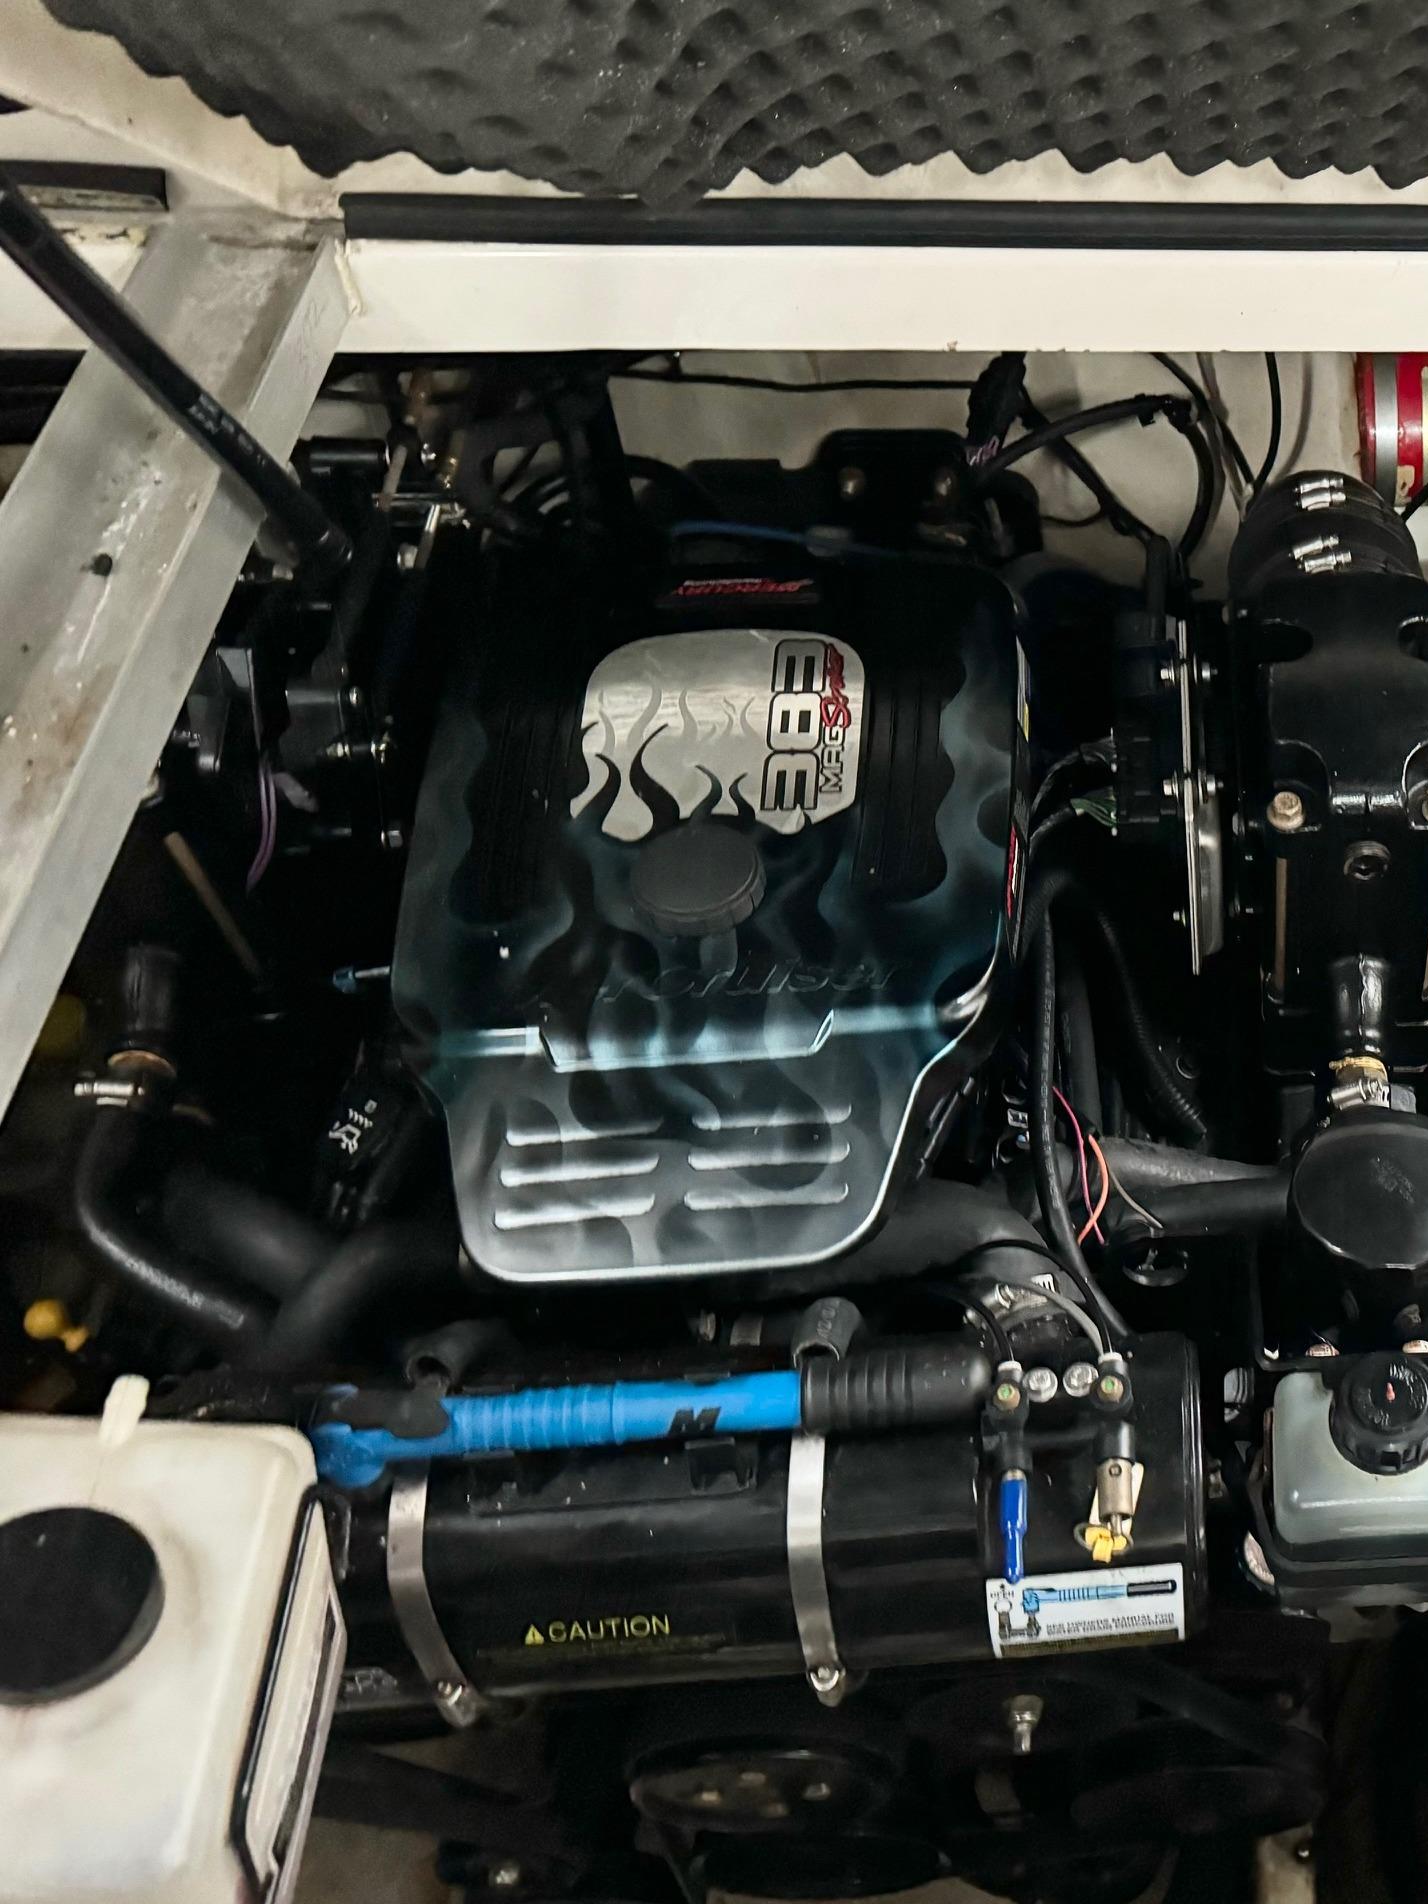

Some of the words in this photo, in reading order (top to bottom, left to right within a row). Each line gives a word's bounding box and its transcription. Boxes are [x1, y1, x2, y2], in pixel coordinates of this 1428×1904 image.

[760, 638, 828, 811] 383
[819, 725, 845, 794] MAG
[548, 1613, 671, 1643] CAUTION
